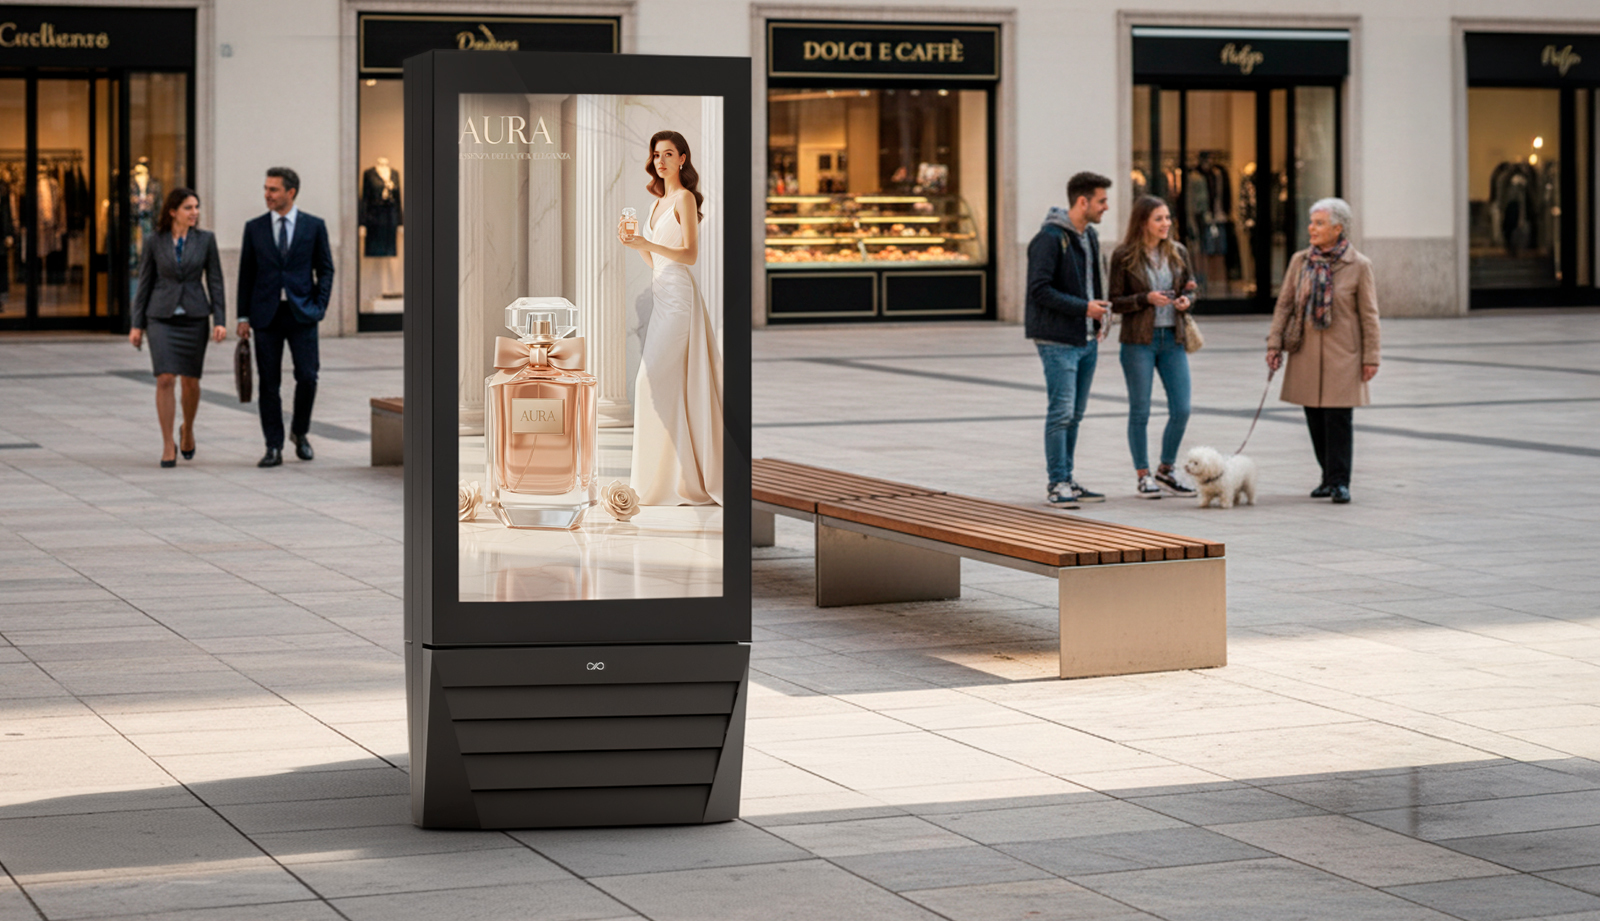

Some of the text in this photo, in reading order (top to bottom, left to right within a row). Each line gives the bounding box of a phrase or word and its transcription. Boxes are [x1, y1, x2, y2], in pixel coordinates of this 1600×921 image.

[803, 38, 964, 62] DOLCI E CAFFÈ
[458, 116, 554, 145] AURA
[520, 410, 556, 422] AURA
